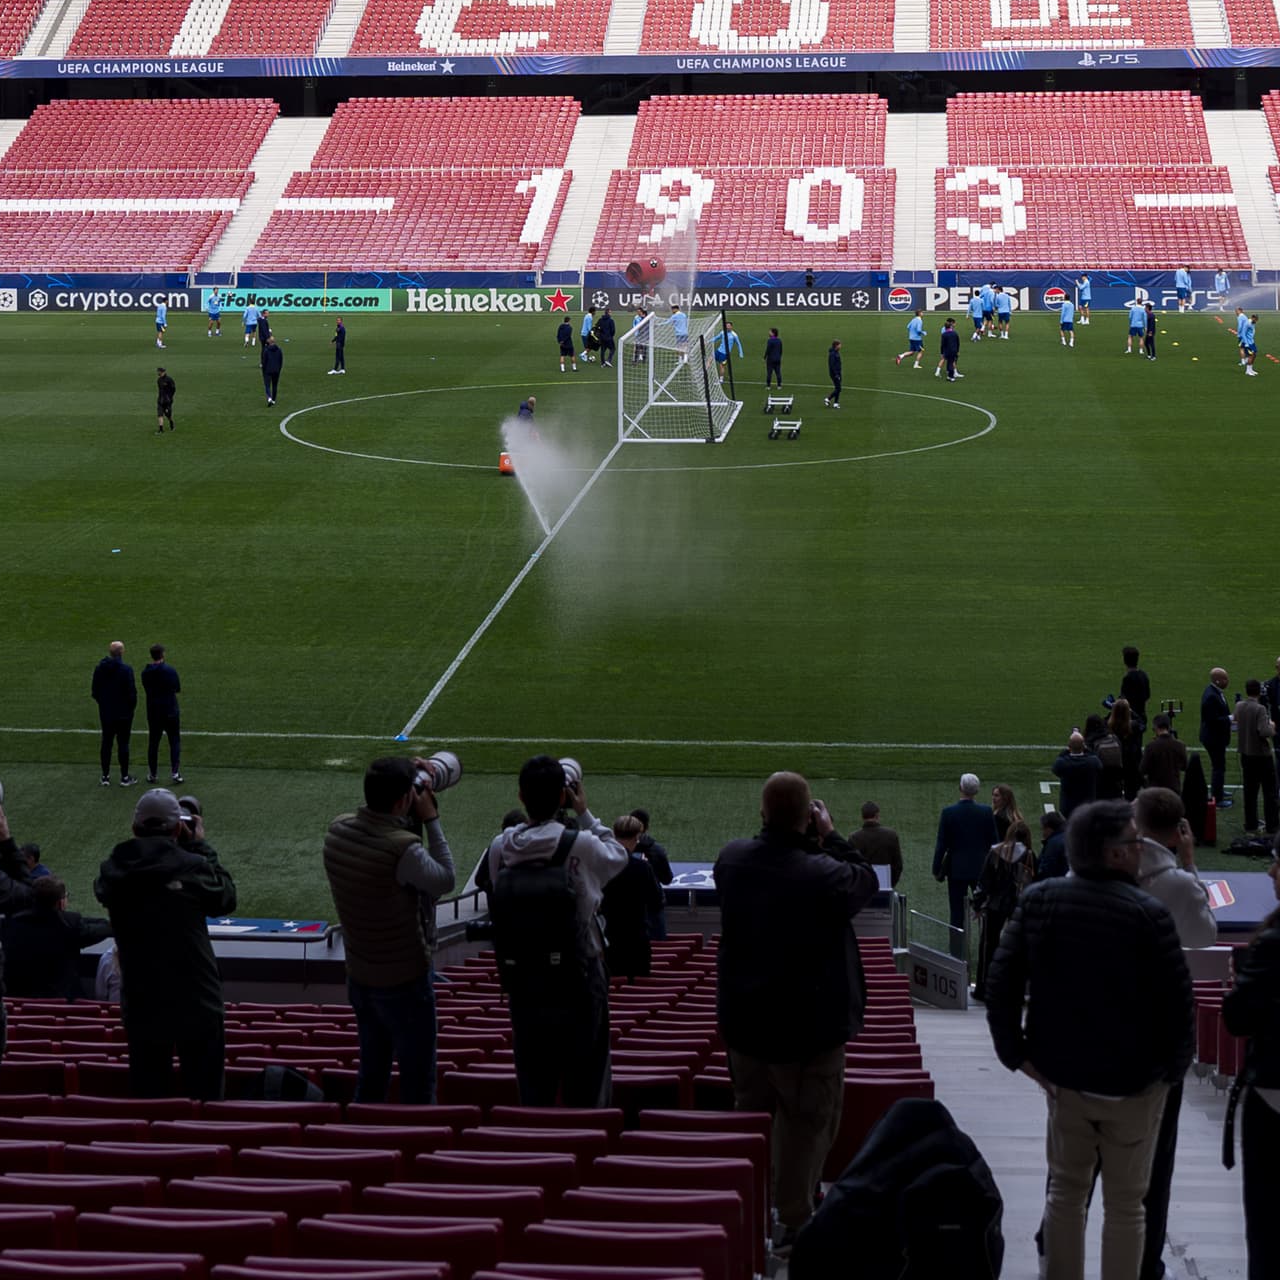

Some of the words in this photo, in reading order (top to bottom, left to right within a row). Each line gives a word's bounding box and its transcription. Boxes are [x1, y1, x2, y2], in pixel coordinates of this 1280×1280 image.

[387, 61, 437, 73] Heineken
[676, 58, 710, 70] UEFA
[712, 57, 793, 69] CHAMPIONS
[795, 56, 847, 69] LEAGUE
[1099, 53, 1137, 64] PS5
[57, 62, 91, 74] UEFA
[93, 62, 172, 74] CHAMPIONS
[174, 61, 225, 74] LEAGUE
[515, 166, 1027, 245] 1903
[406, 288, 543, 312] Heineken
[669, 291, 770, 308] CHAMPIONS
[776, 291, 843, 308] LEAGUE
[926, 287, 1029, 311] PESI
[931, 973, 957, 999] 105
